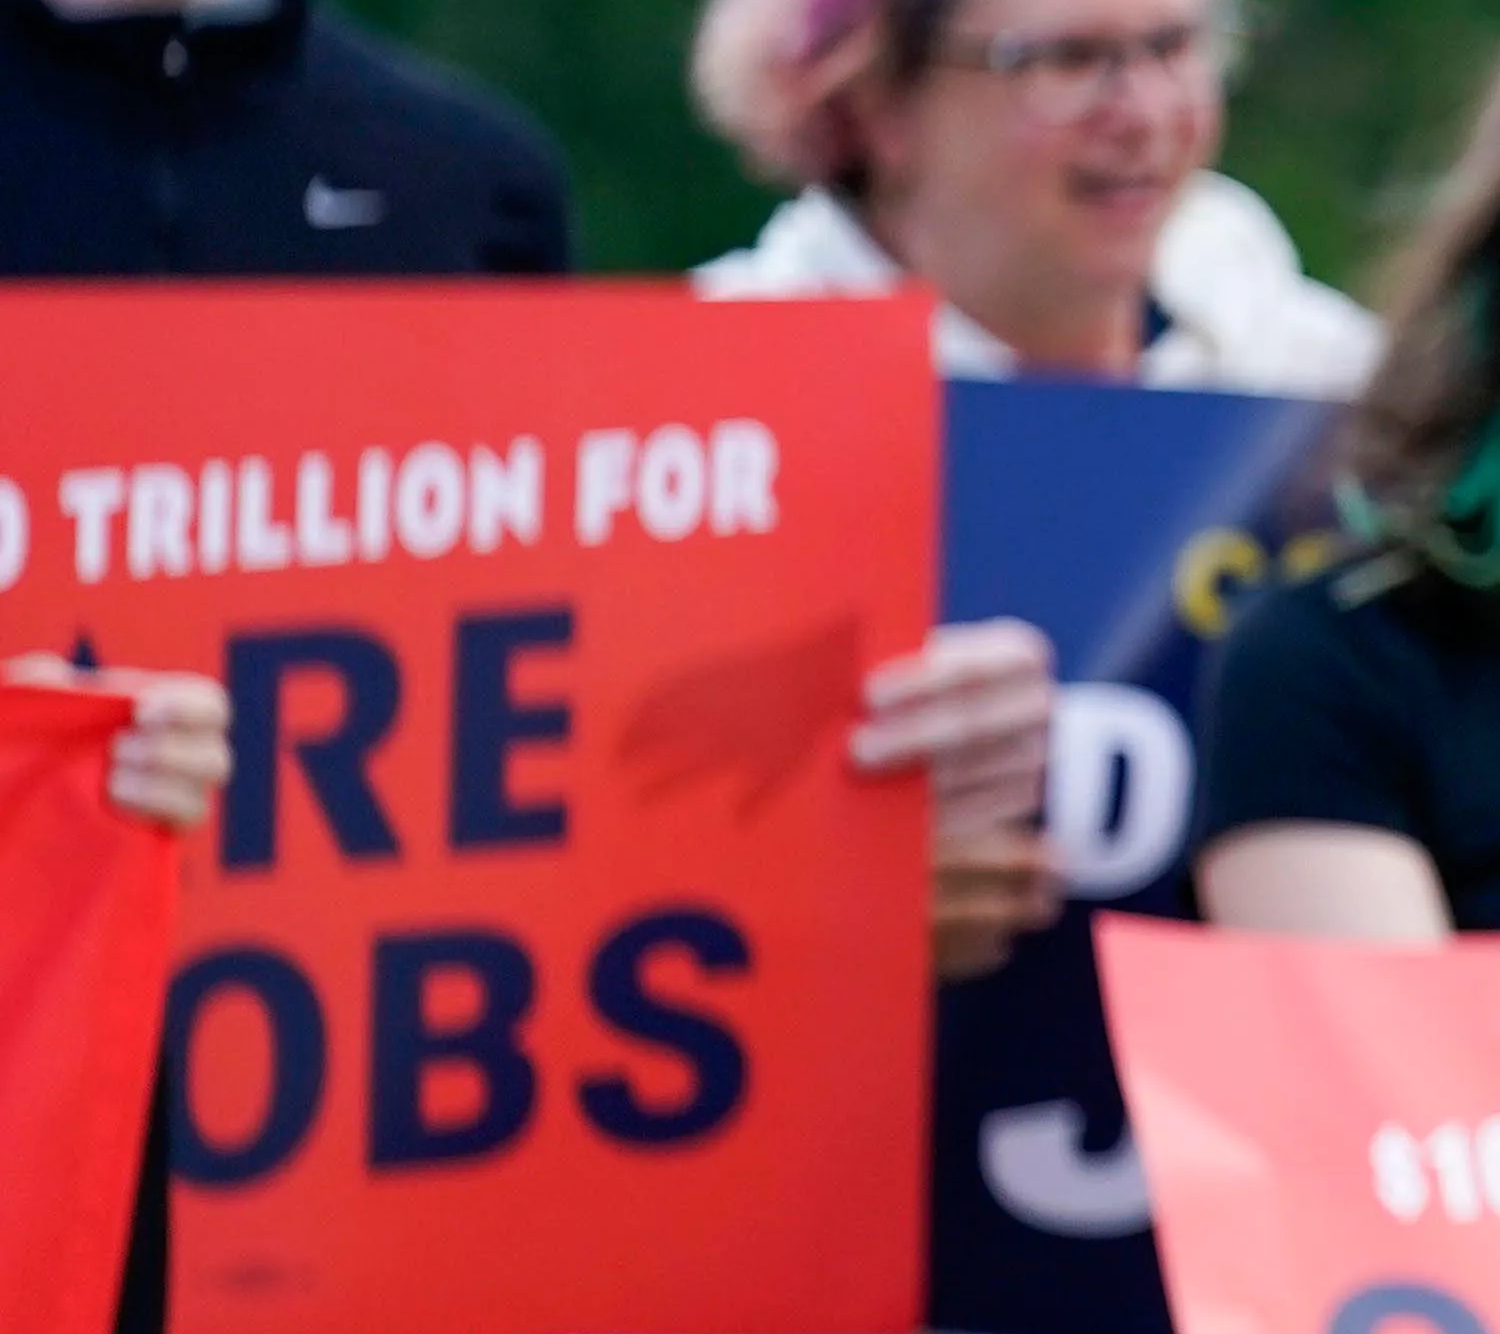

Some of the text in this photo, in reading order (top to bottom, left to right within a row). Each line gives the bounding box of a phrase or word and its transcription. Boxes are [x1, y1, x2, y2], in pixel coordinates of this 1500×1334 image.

[60, 433, 541, 584] TRILLION
[577, 419, 780, 547] FOR
[72, 603, 577, 875] RE
[167, 907, 756, 1193] OBS
